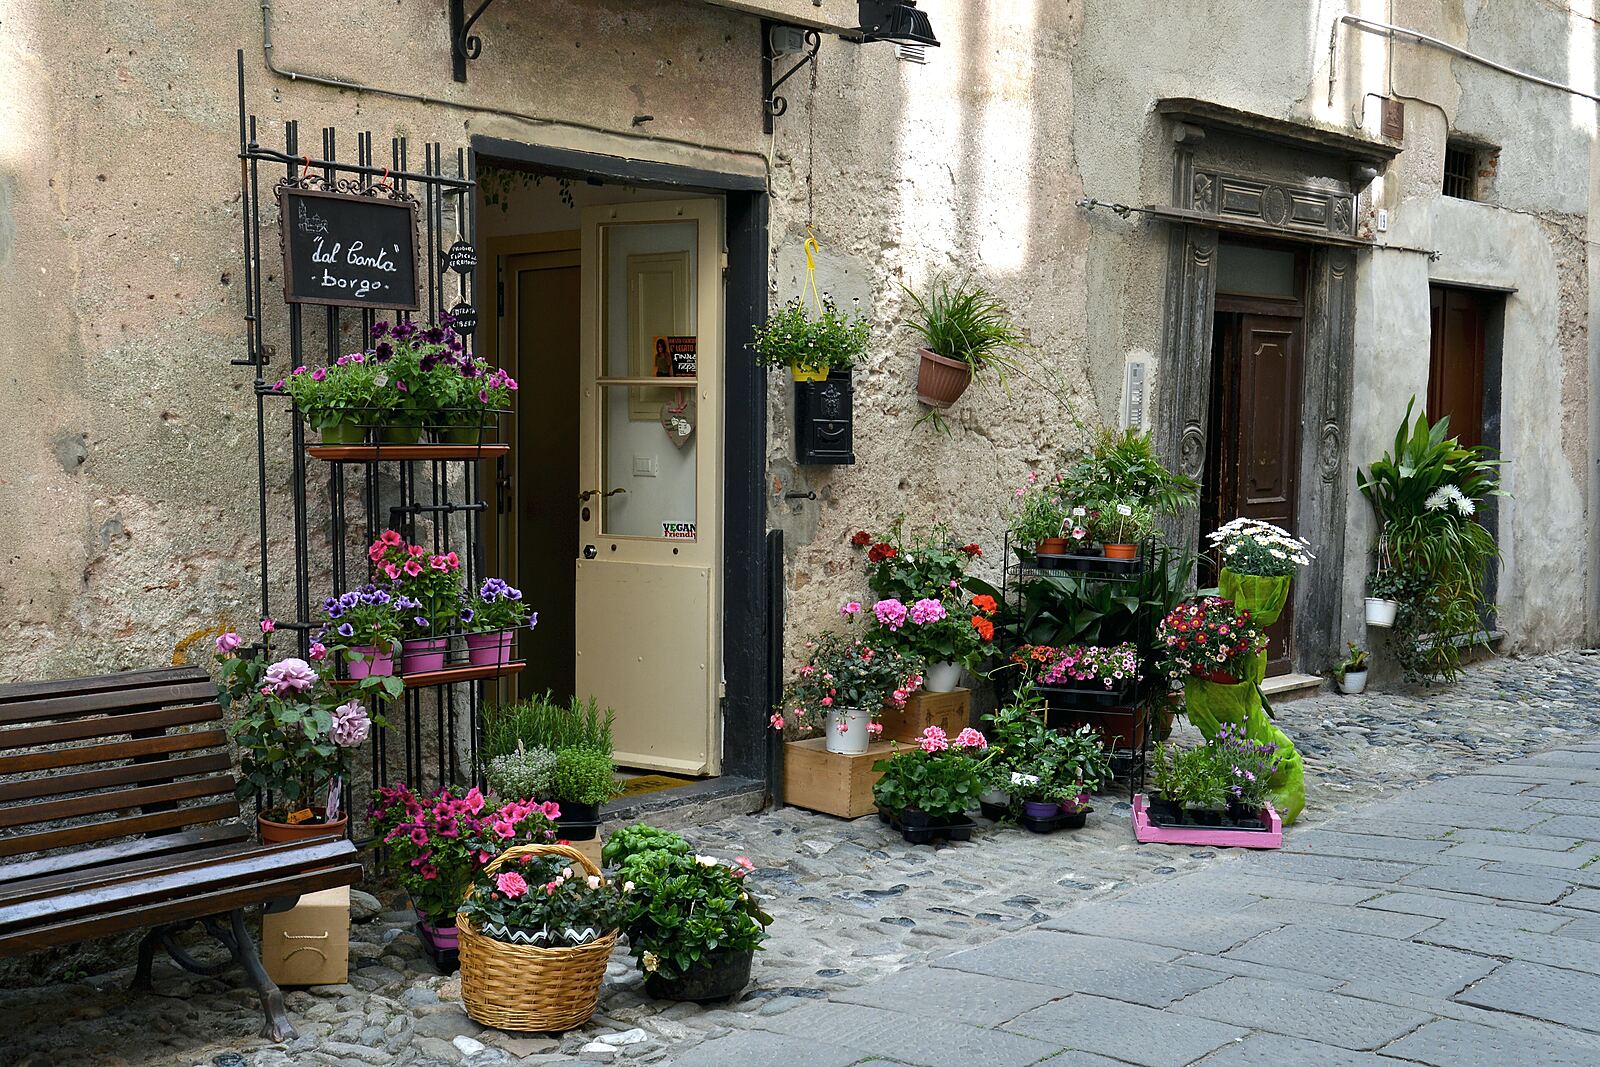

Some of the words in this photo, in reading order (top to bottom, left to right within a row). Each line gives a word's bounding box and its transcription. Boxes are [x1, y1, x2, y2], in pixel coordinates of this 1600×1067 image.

[451, 307, 476, 317] ENTRATA
[452, 320, 476, 328] LIBERA
[663, 523, 696, 532] VEGAN
[664, 530, 697, 539] Friendly
